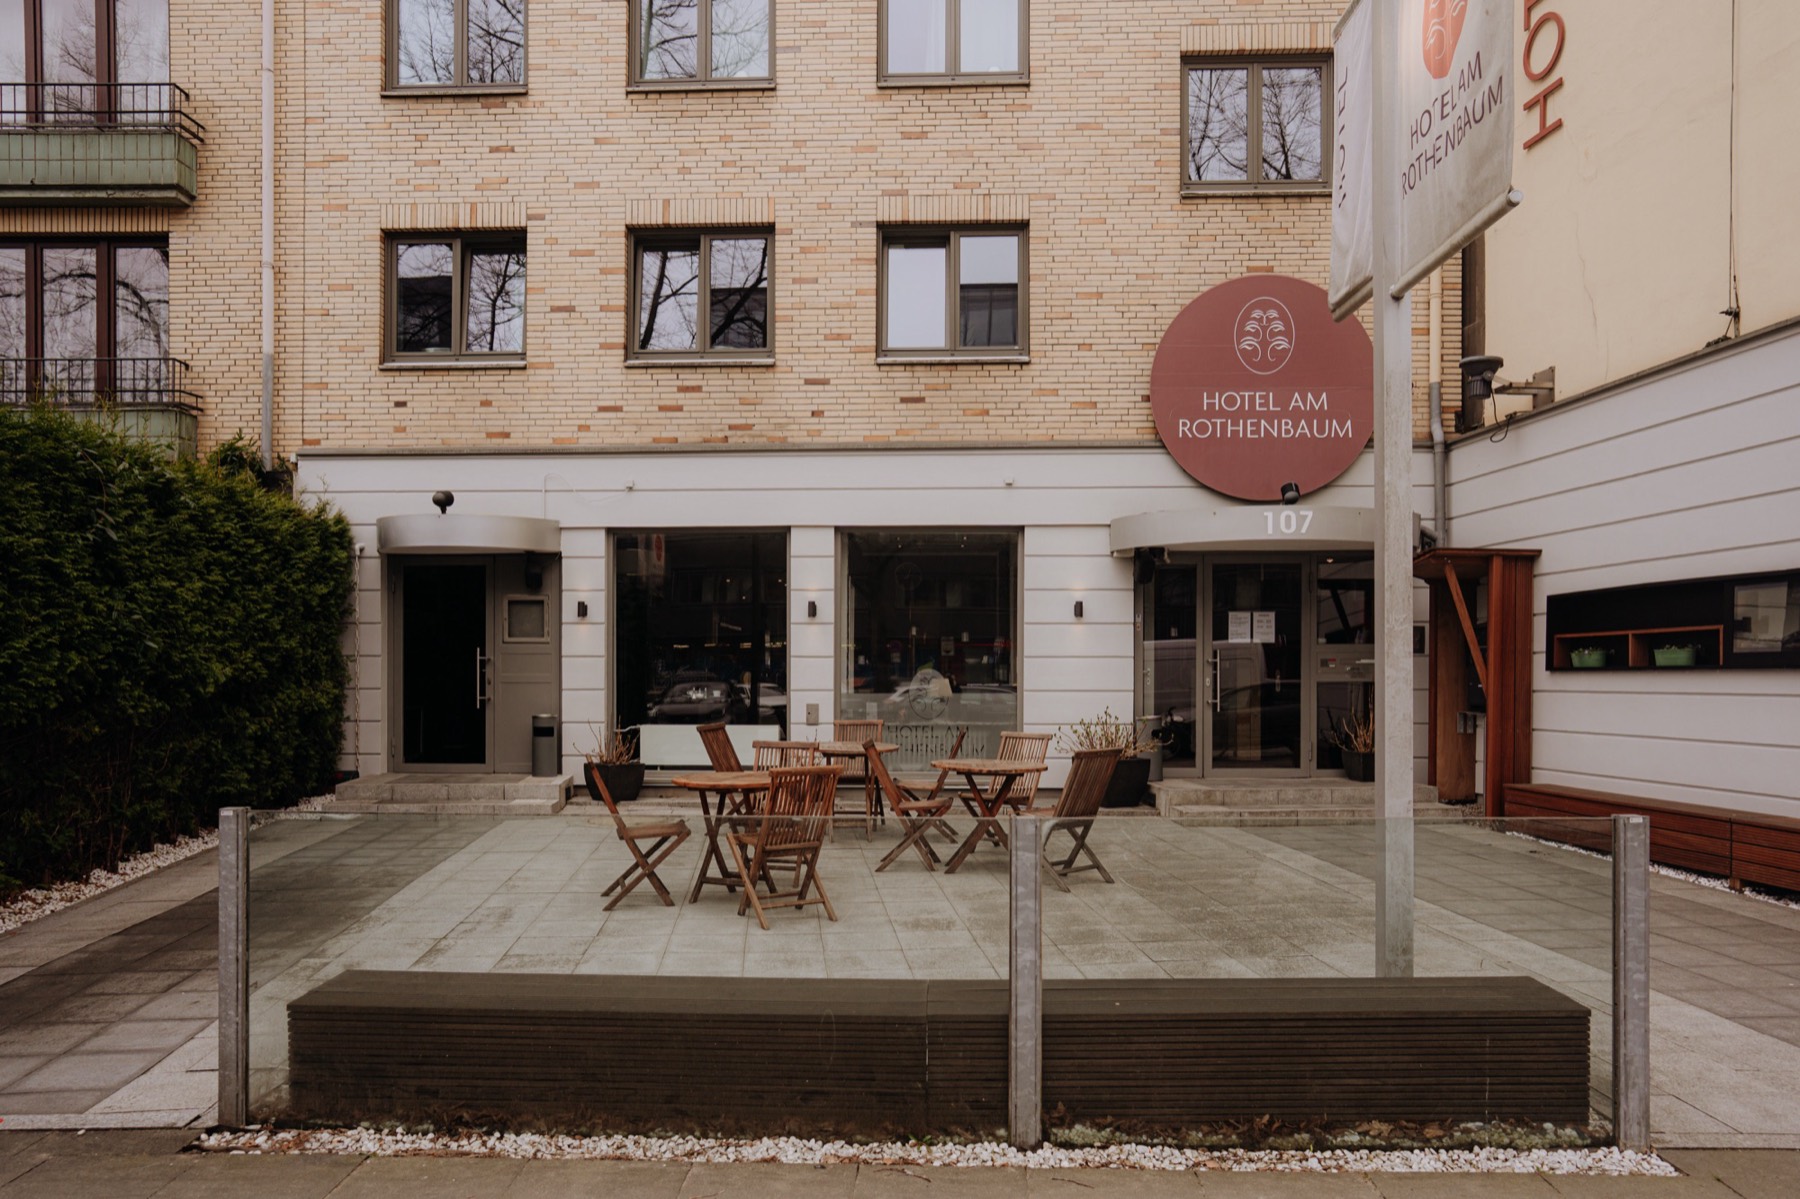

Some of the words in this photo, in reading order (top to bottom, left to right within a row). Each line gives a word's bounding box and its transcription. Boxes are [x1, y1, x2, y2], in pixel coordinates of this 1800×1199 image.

[1410, 84, 1457, 150] HOTEL
[1458, 51, 1482, 100] AM
[1401, 75, 1503, 200] ROTHENBAUM
[1203, 391, 1281, 411] HOTEL
[1289, 391, 1328, 411] AM
[1178, 418, 1353, 439] ROTHENBAUM
[1263, 510, 1314, 535] 107
[887, 725, 939, 739] HOTEL
[945, 725, 970, 739] AM
